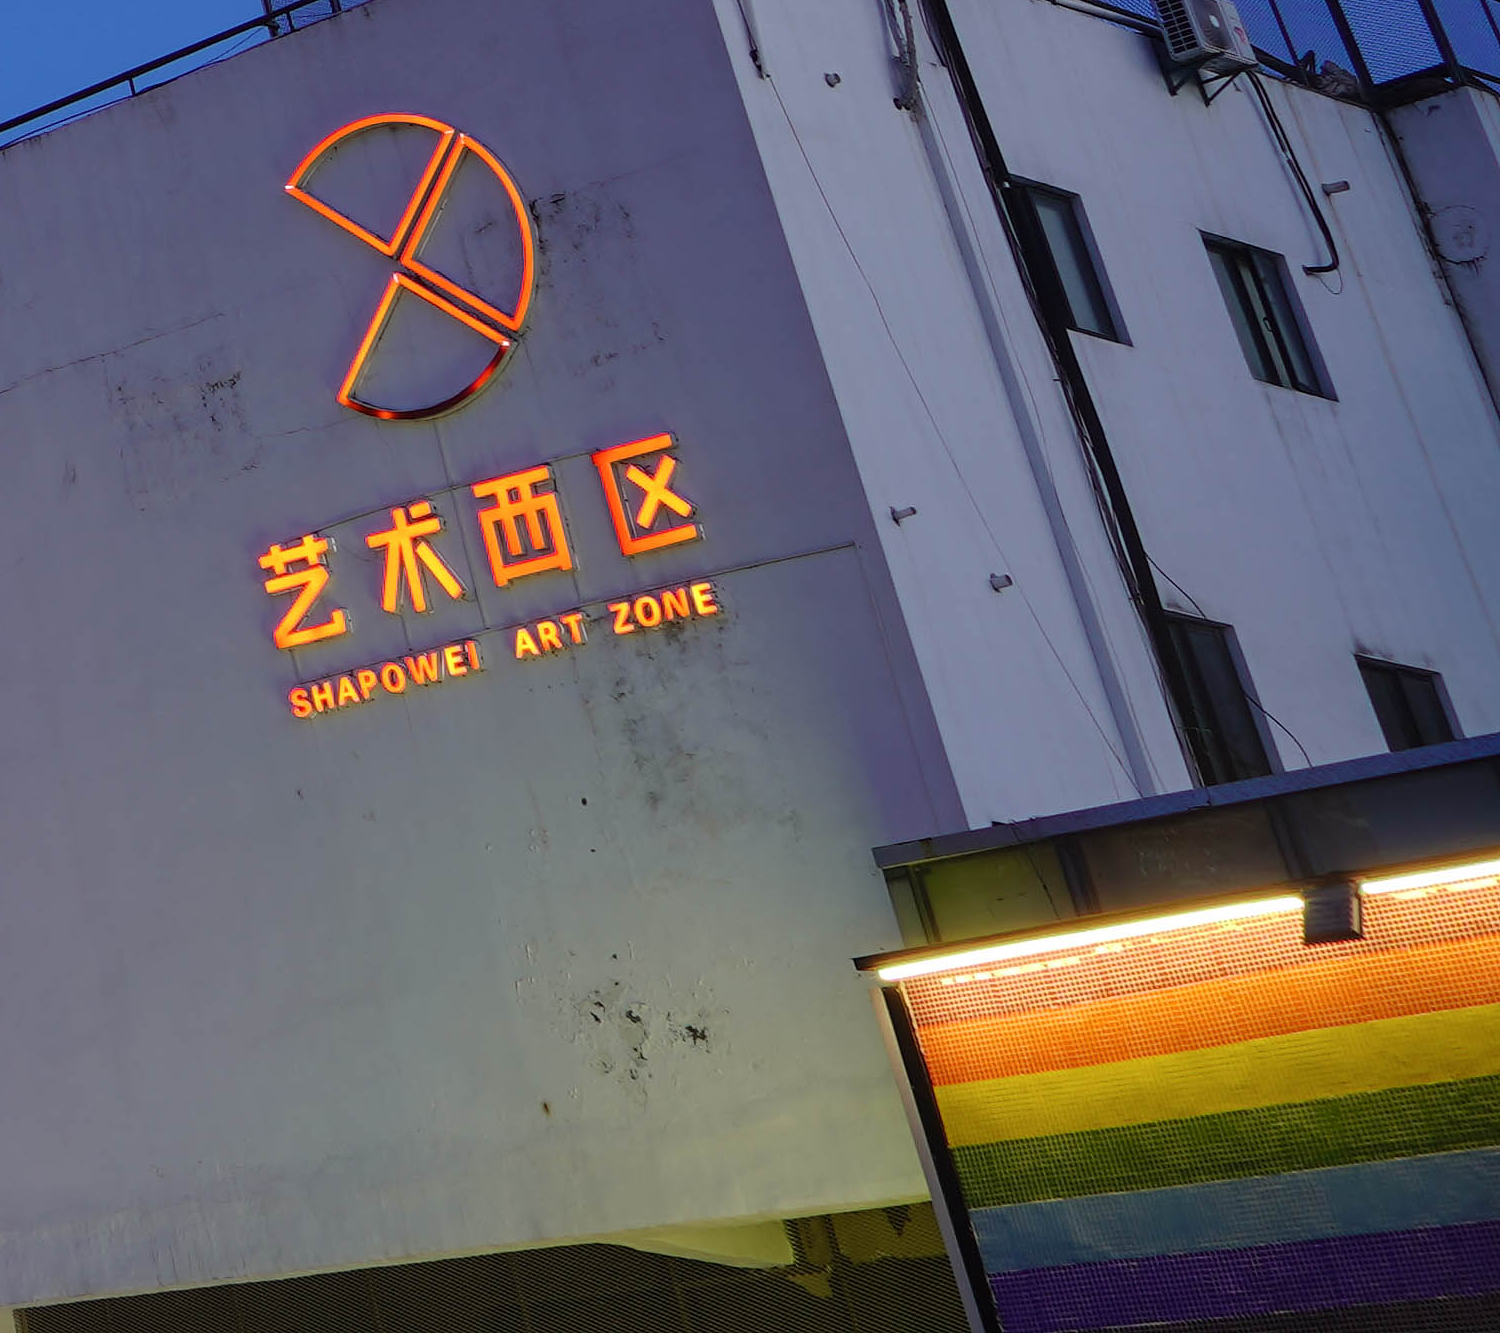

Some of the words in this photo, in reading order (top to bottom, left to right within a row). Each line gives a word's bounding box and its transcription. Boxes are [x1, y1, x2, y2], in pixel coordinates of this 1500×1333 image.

[258, 432, 699, 650] 艺术西区
[289, 640, 482, 718] SHAPOWEI
[515, 612, 586, 659] ART
[609, 582, 717, 634] ZONE
